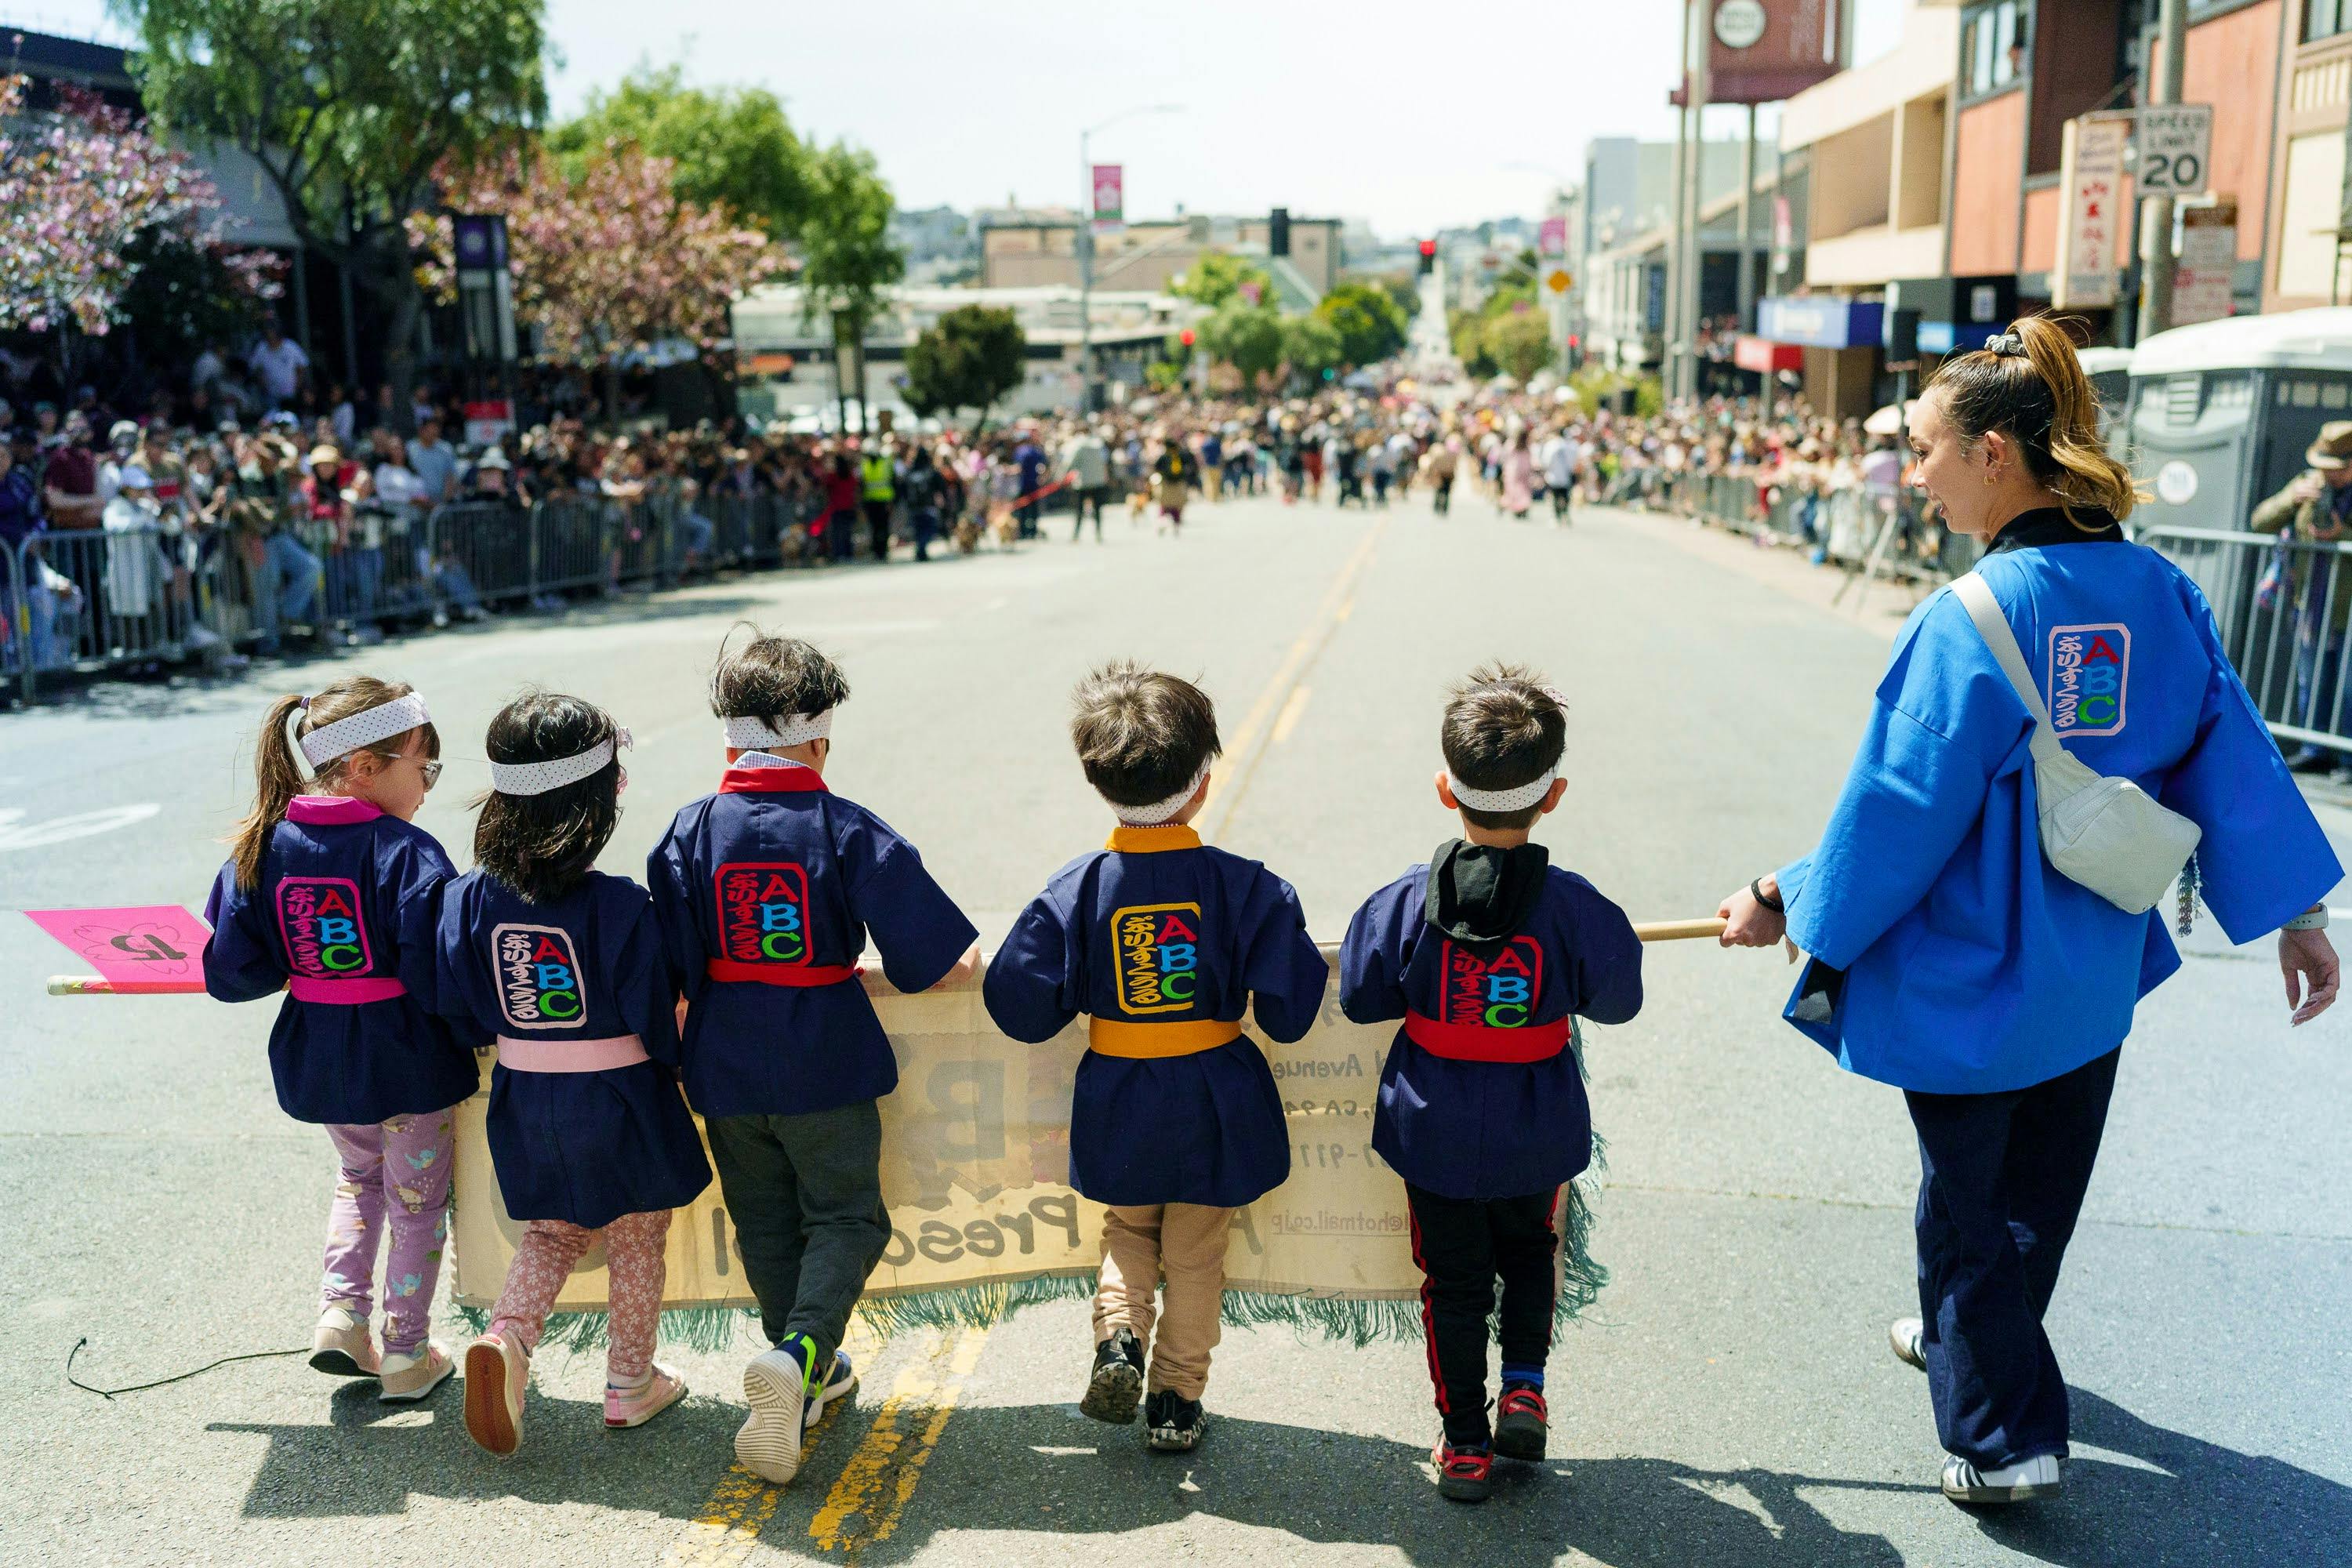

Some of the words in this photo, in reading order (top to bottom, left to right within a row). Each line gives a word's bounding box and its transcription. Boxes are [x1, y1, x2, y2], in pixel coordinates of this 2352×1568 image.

[2143, 154, 2200, 187] 20
[2078, 635, 2120, 725] ABC
[110, 934, 187, 960] 15
[316, 888, 363, 970] ABC
[759, 873, 803, 959] ABC
[532, 936, 579, 1017] ABC
[1156, 915, 1198, 1000] ABC
[1486, 946, 1531, 1028] ABC
